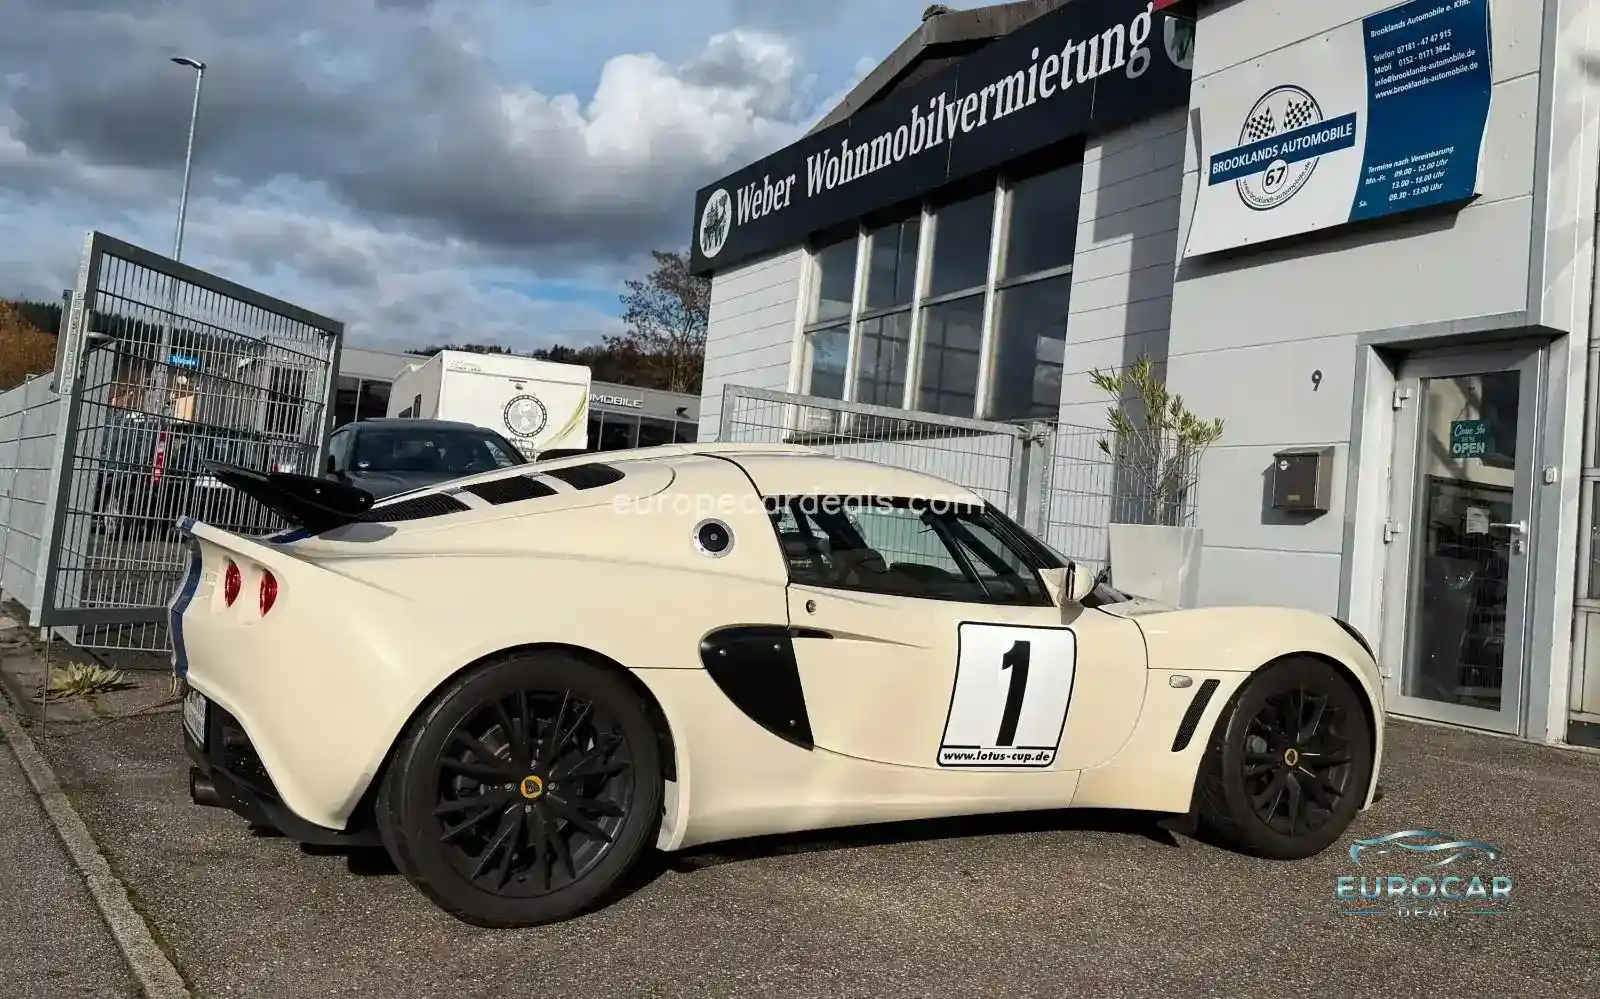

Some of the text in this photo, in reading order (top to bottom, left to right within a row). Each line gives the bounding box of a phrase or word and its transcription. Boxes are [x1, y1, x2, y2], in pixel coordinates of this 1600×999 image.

[1370, 20, 1406, 38] Brooklands
[1407, 7, 1445, 26] Automobile
[1373, 50, 1395, 63] Telefon
[1396, 42, 1416, 54] 07181
[1421, 37, 1429, 46] 47
[1430, 34, 1438, 43] 47
[1439, 29, 1452, 40] 915
[1374, 63, 1393, 75] Mobil
[1399, 56, 1414, 67] 0152
[1419, 50, 1434, 60] 0171
[1435, 43, 1451, 55] 3642
[1375, 49, 1476, 87] info@brooklands-automobile.de
[1375, 62, 1479, 99] www.brooklands-automobile.de
[737, 2, 1154, 226] Weber Wohnmobilvermietung
[1212, 123, 1353, 174] BROOKLANDS AUTOMOBILE
[1265, 166, 1286, 187] 67
[1311, 369, 1323, 392] 9
[1452, 442, 1486, 454] OPEN
[995, 640, 1031, 746] 1
[943, 751, 1050, 763] www.lotus-cup.de
